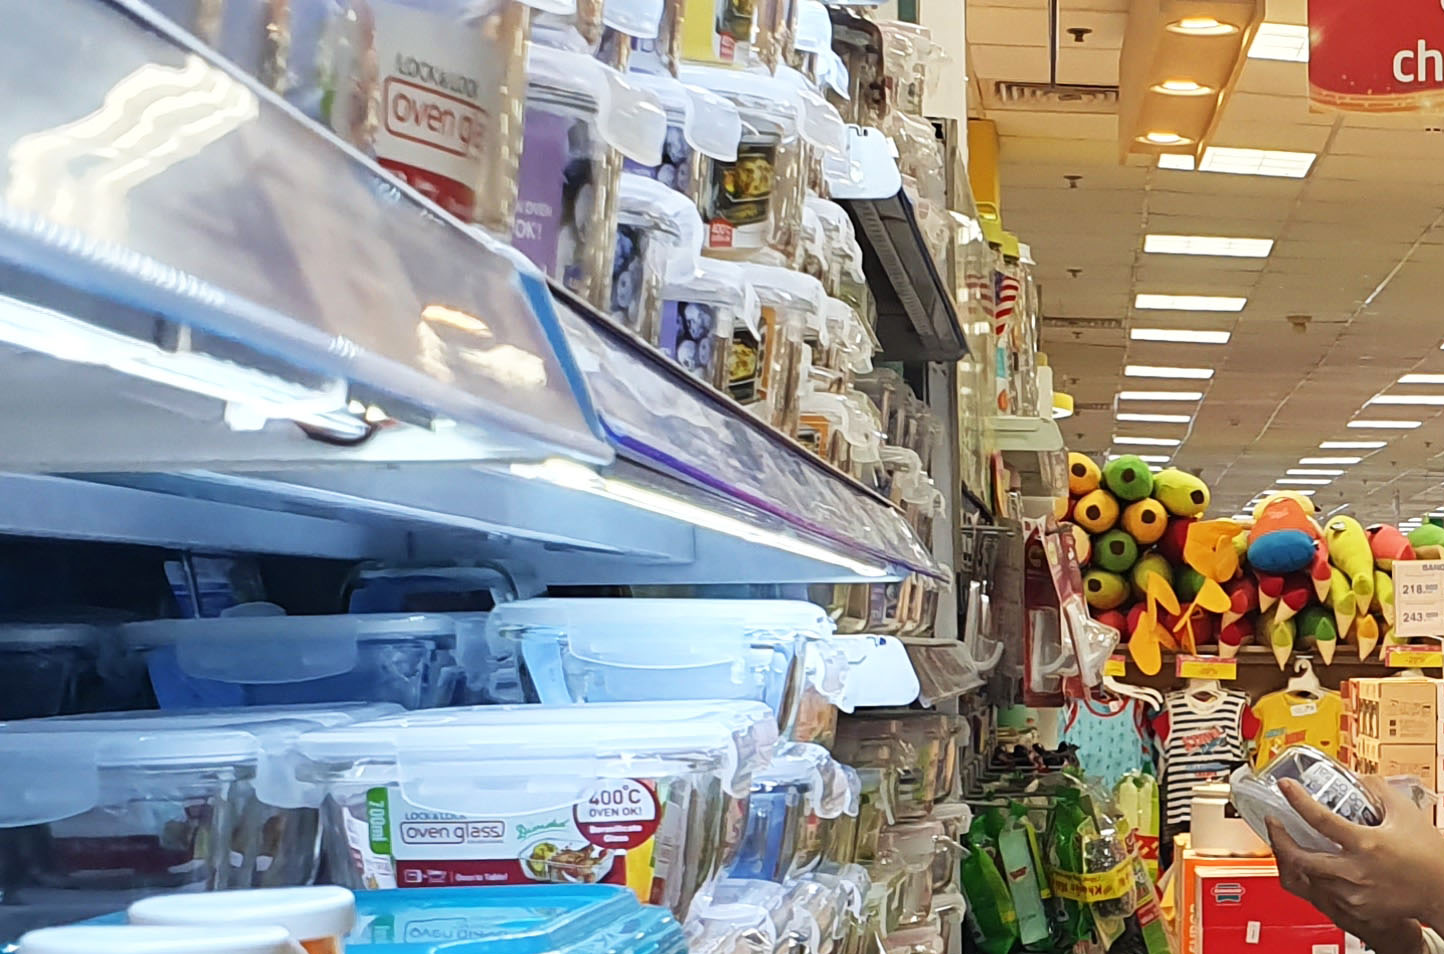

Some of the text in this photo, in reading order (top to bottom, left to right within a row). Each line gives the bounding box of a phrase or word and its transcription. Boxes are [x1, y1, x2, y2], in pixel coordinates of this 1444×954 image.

[589, 806, 642, 818] OVEN OK!
[406, 826, 450, 839] oven
[453, 823, 501, 843] glass
